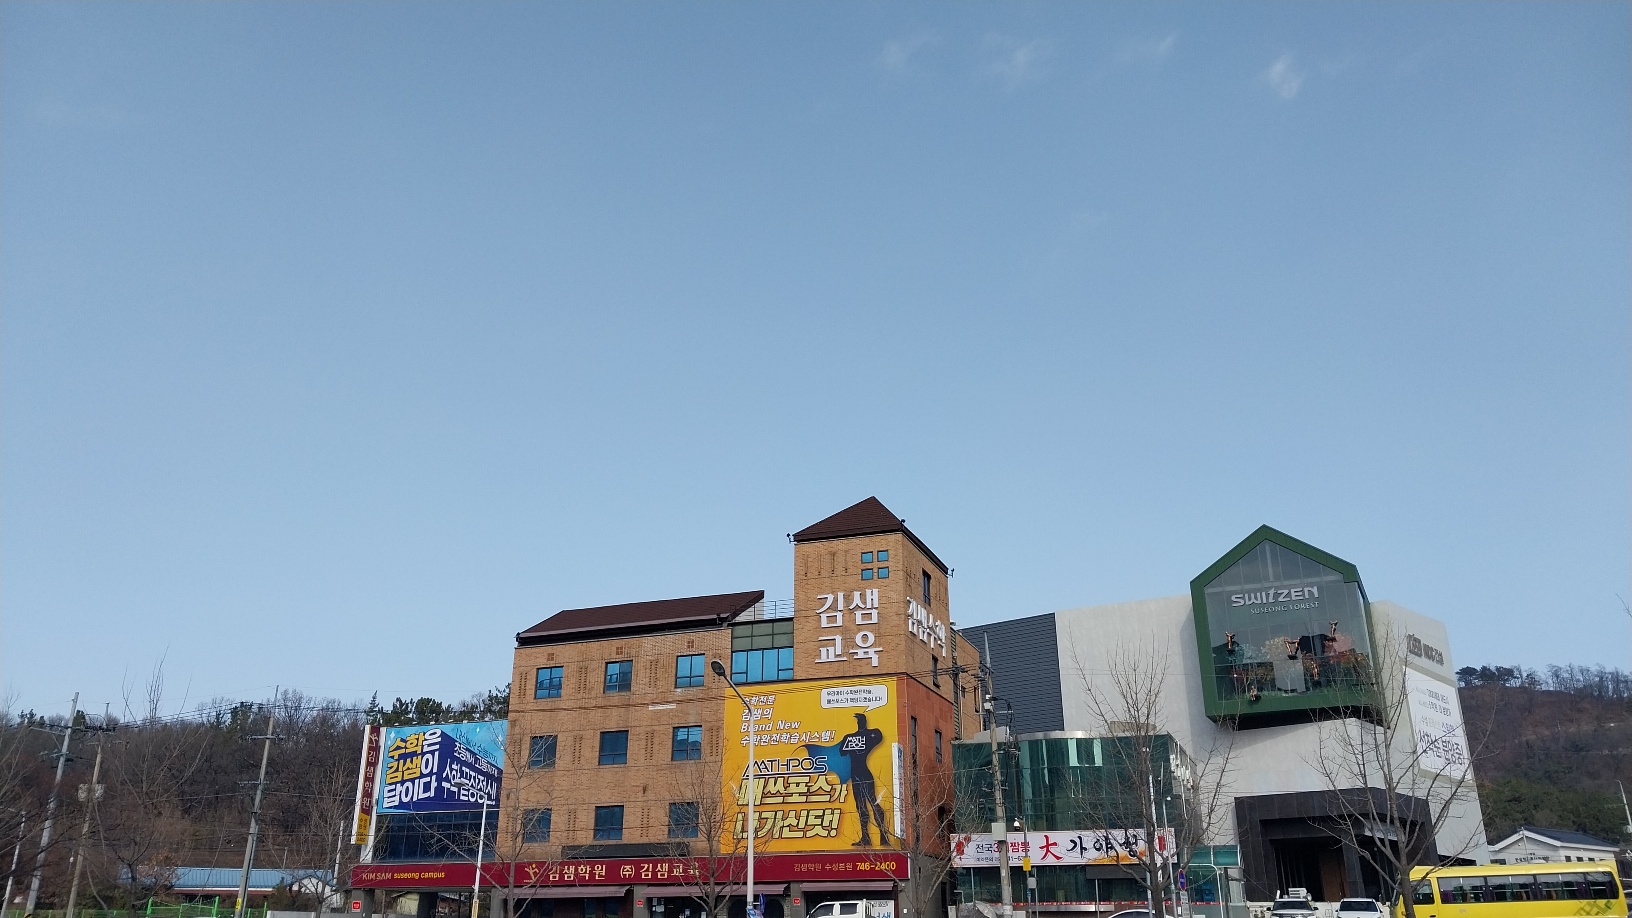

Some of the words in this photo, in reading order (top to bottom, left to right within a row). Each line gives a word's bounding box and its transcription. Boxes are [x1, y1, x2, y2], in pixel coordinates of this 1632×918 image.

[816, 588, 879, 628] 김샘
[1250, 606, 1287, 615] SUSEONG
[1290, 601, 1319, 611] FOREST
[907, 596, 946, 657] 김샘수학
[815, 630, 883, 667] 교육
[741, 694, 776, 706] 수학전문
[741, 708, 773, 721] 김샘의
[776, 720, 801, 731] New
[388, 728, 442, 759] 수학은
[362, 751, 376, 809] 김샘학원
[386, 751, 438, 784] 김샘이
[383, 775, 437, 808] 답이다
[733, 808, 841, 839] 나가신닷!
[1038, 834, 1063, 861] 大
[362, 872, 376, 880] KIM
[376, 872, 391, 880] SAM
[420, 871, 445, 879] campus
[548, 863, 606, 881] 김샘학원
[793, 863, 822, 872] 김샘학원
[824, 862, 853, 871] 수성본원
[855, 861, 897, 871] 746-2400
